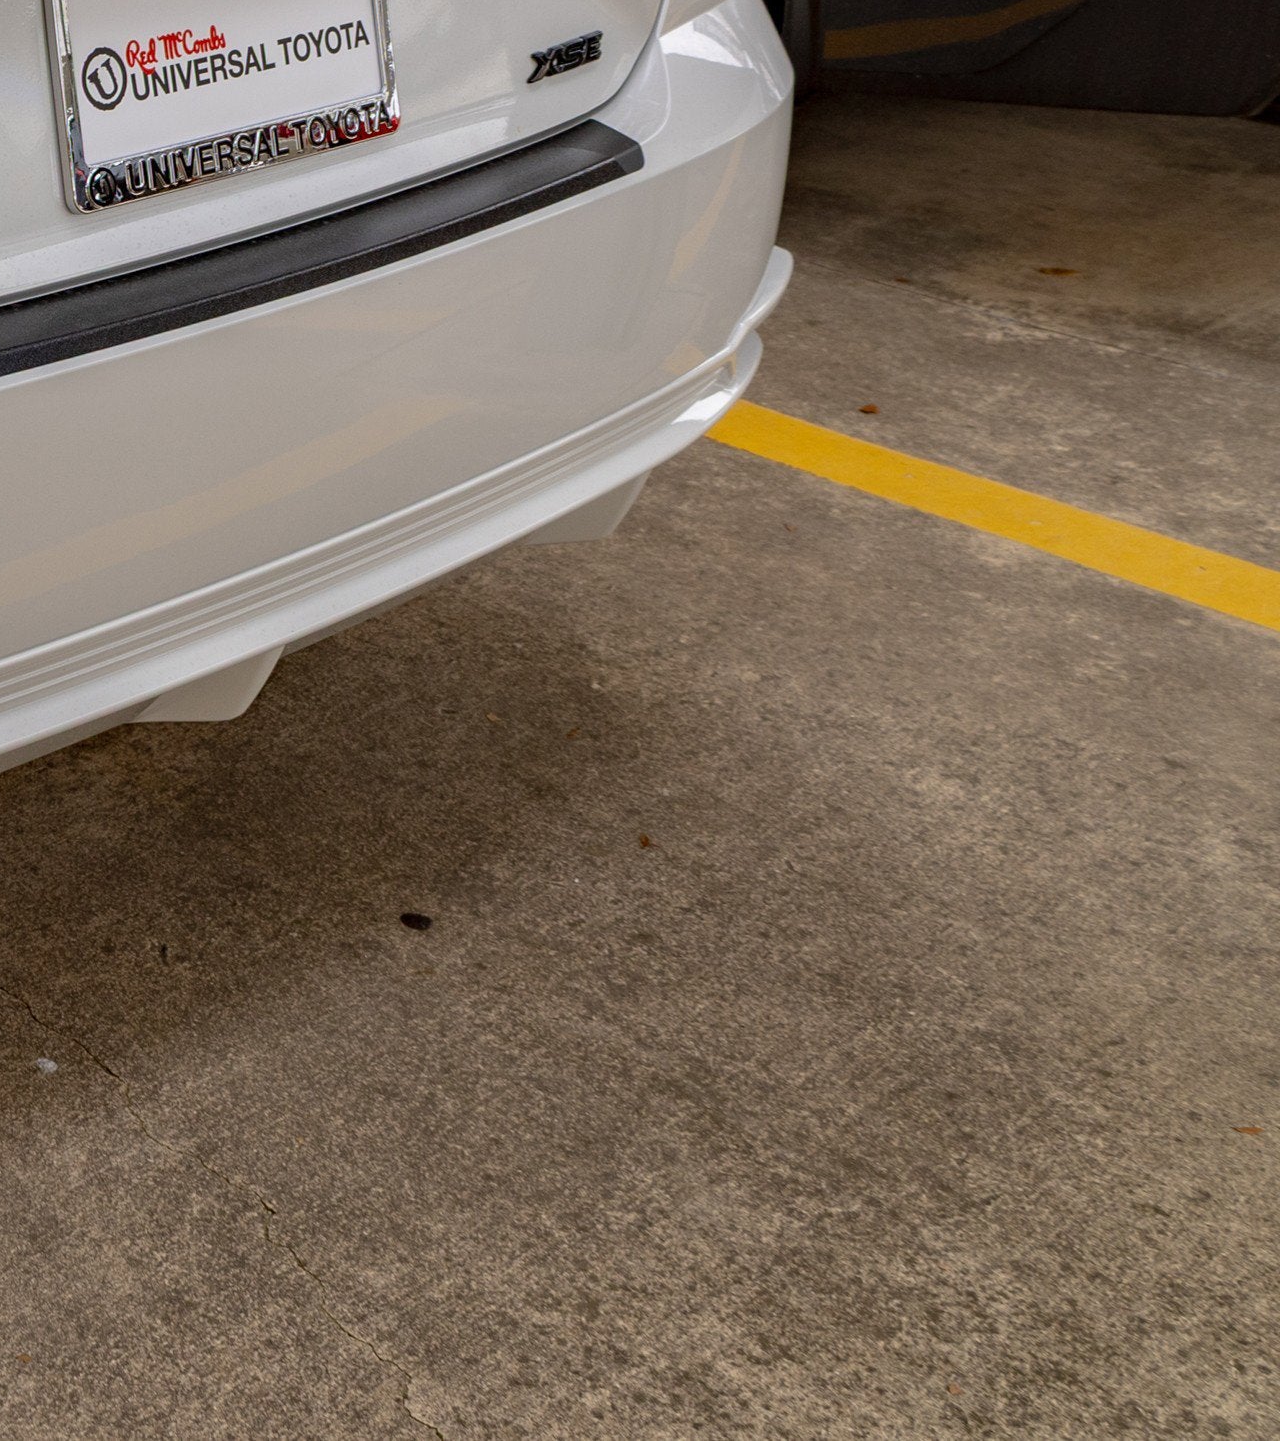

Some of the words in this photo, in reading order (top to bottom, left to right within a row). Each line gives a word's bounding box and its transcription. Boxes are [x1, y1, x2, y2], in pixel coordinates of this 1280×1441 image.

[125, 39, 159, 76] Red
[157, 24, 227, 60] McCombs
[130, 43, 276, 101] UNIVERSAL
[277, 19, 370, 66] TOYOTA
[526, 29, 604, 84] XSE
[125, 122, 289, 196] UNIVERSAL
[289, 99, 395, 153] TOYOTA
